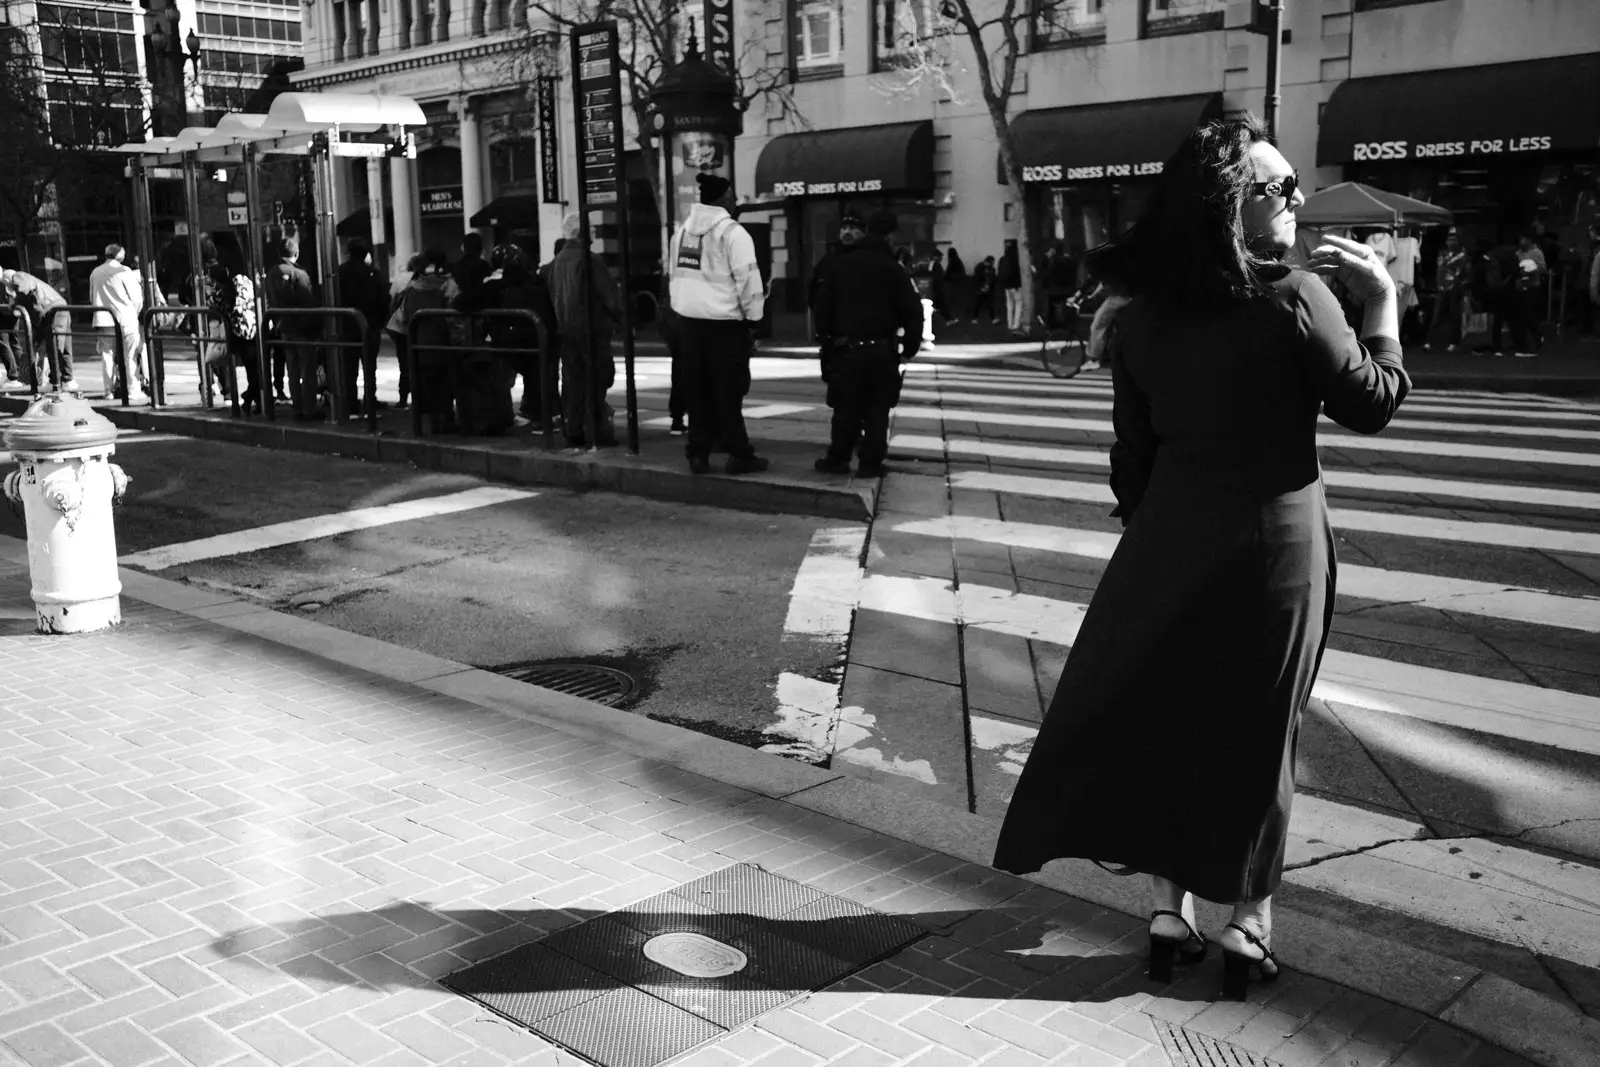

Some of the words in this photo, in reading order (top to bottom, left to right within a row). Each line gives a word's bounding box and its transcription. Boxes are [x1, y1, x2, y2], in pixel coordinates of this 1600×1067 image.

[711, 0, 730, 74] SS
[1354, 141, 1407, 161] ROSS
[1415, 142, 1464, 158] DRESS
[1470, 139, 1503, 154] FOR
[1509, 136, 1552, 152] LESS
[1022, 165, 1062, 181] ROSS
[1067, 166, 1104, 180] DRESS
[1106, 164, 1131, 177] FOR
[1133, 161, 1164, 175] LESS
[773, 181, 805, 197] ROSS
[807, 183, 836, 195] DRESS
[837, 181, 857, 193] FOR
[858, 179, 881, 192] LESS
